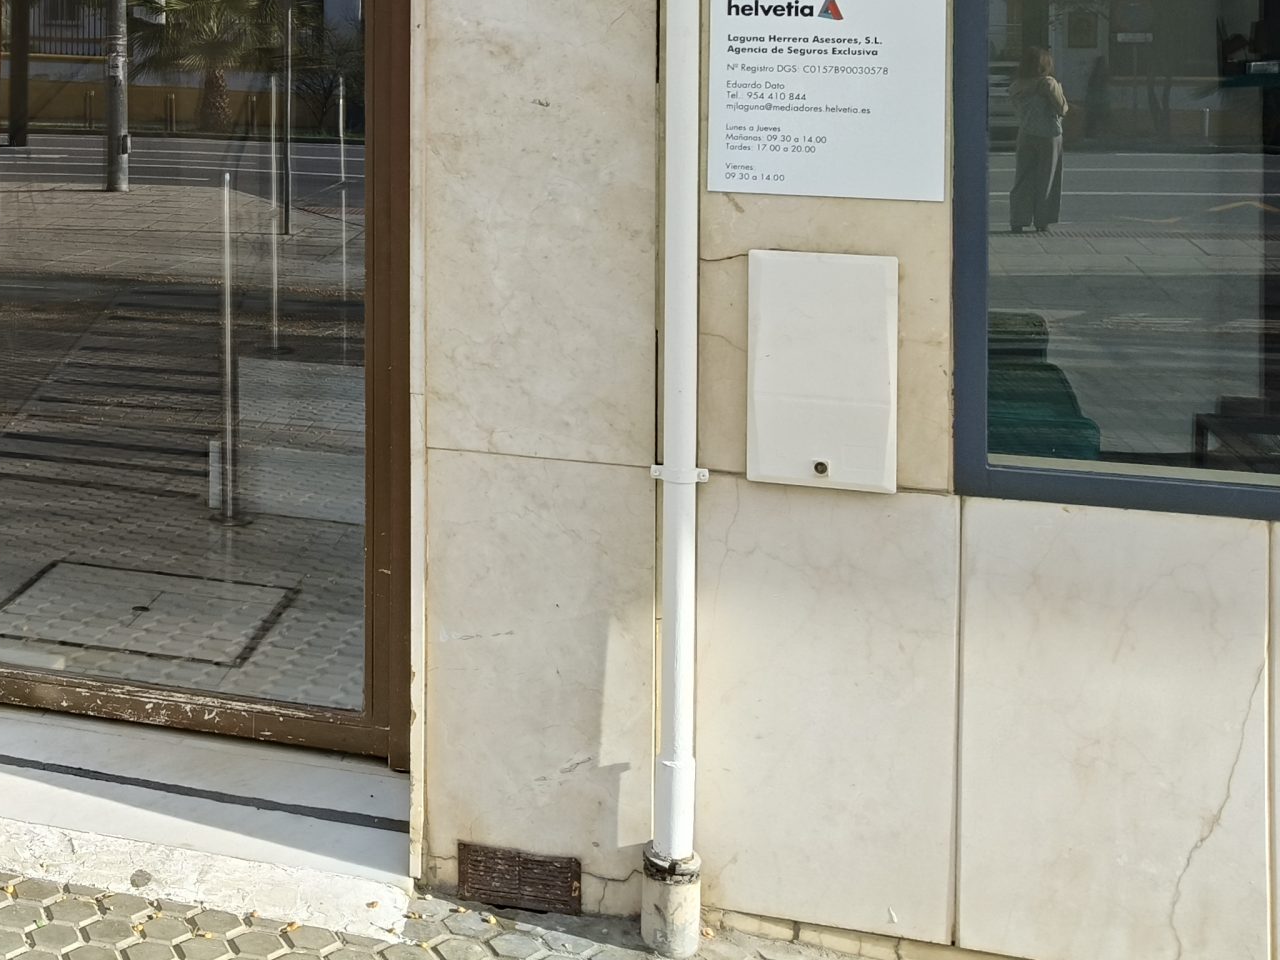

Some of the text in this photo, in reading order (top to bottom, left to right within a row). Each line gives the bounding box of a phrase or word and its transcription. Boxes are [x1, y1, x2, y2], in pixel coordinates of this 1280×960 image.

[727, 0, 814, 17] helvetia
[727, 34, 883, 45] Laguna Herrera Asesores, S.L.
[727, 45, 878, 57] Agencia de Seguros Exclusiva
[741, 64, 774, 75] Registro
[726, 80, 785, 90] Eduardo Dato
[747, 92, 764, 100] 954
[768, 92, 786, 101] 410
[788, 93, 807, 101] 844
[725, 123, 746, 131] Lunes
[756, 124, 781, 132] Jueves
